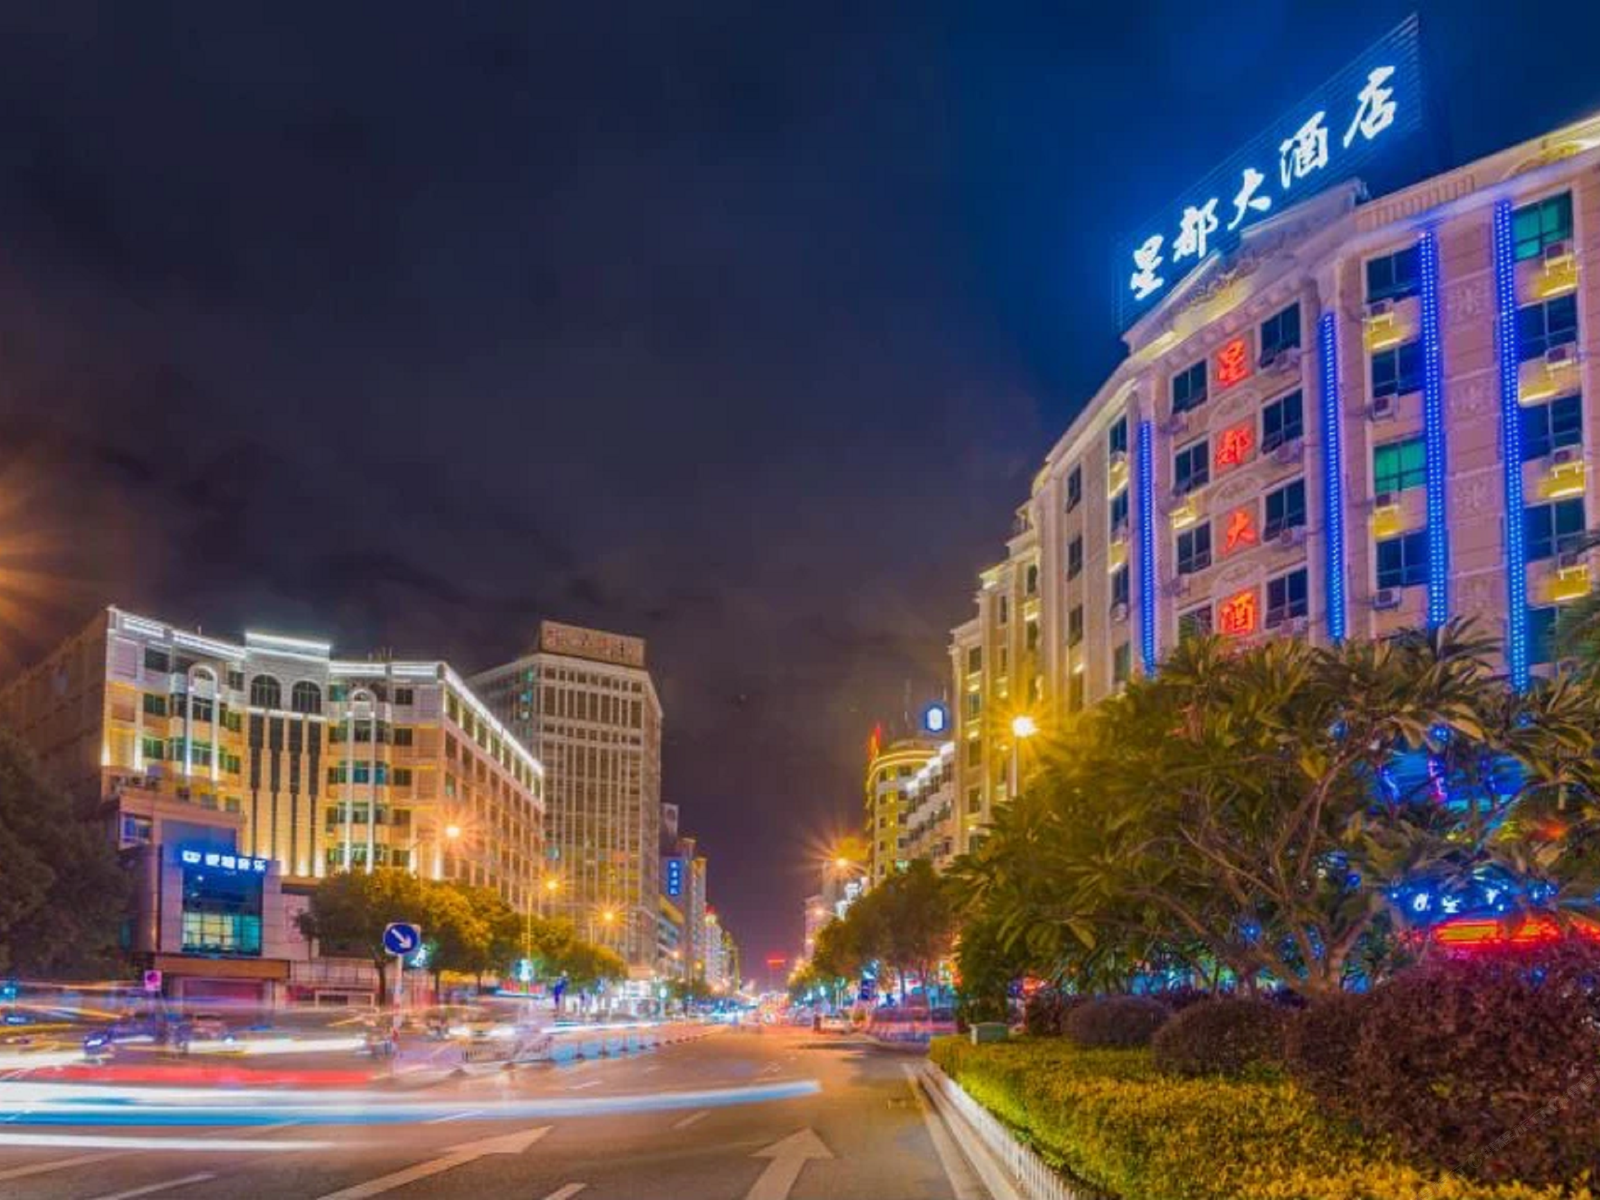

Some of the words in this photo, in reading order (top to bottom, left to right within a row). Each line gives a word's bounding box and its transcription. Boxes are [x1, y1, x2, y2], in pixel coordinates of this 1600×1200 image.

[1130, 65, 1397, 301] 星都大酒店
[1215, 337, 1257, 635] 星都大酒
